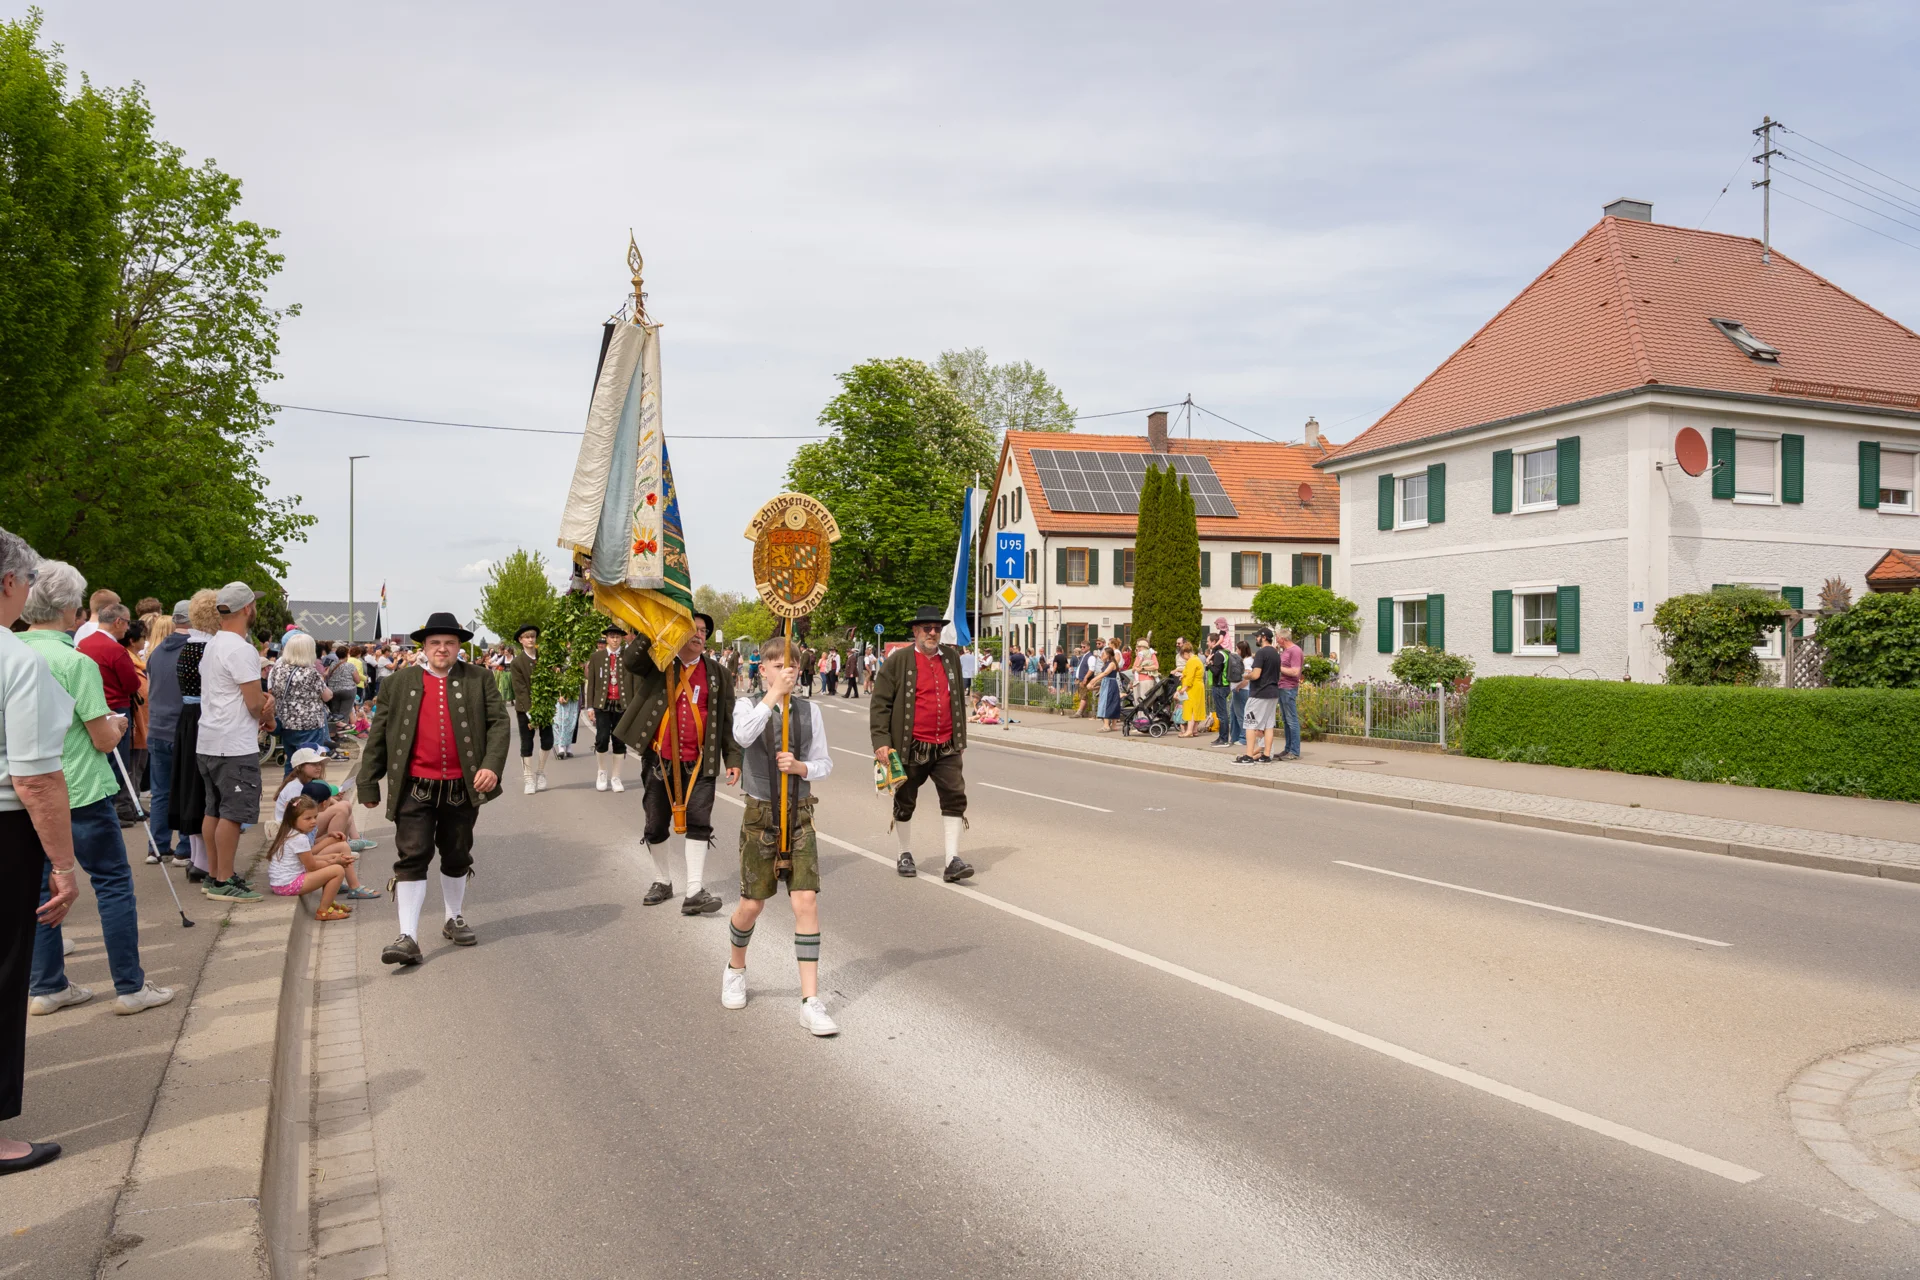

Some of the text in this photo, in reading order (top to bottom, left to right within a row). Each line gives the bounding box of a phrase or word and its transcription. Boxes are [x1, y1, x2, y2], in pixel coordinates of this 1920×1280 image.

[752, 496, 836, 534] Schützenverein
[999, 539, 1022, 551] U 95
[763, 590, 823, 617] Attenhofen
